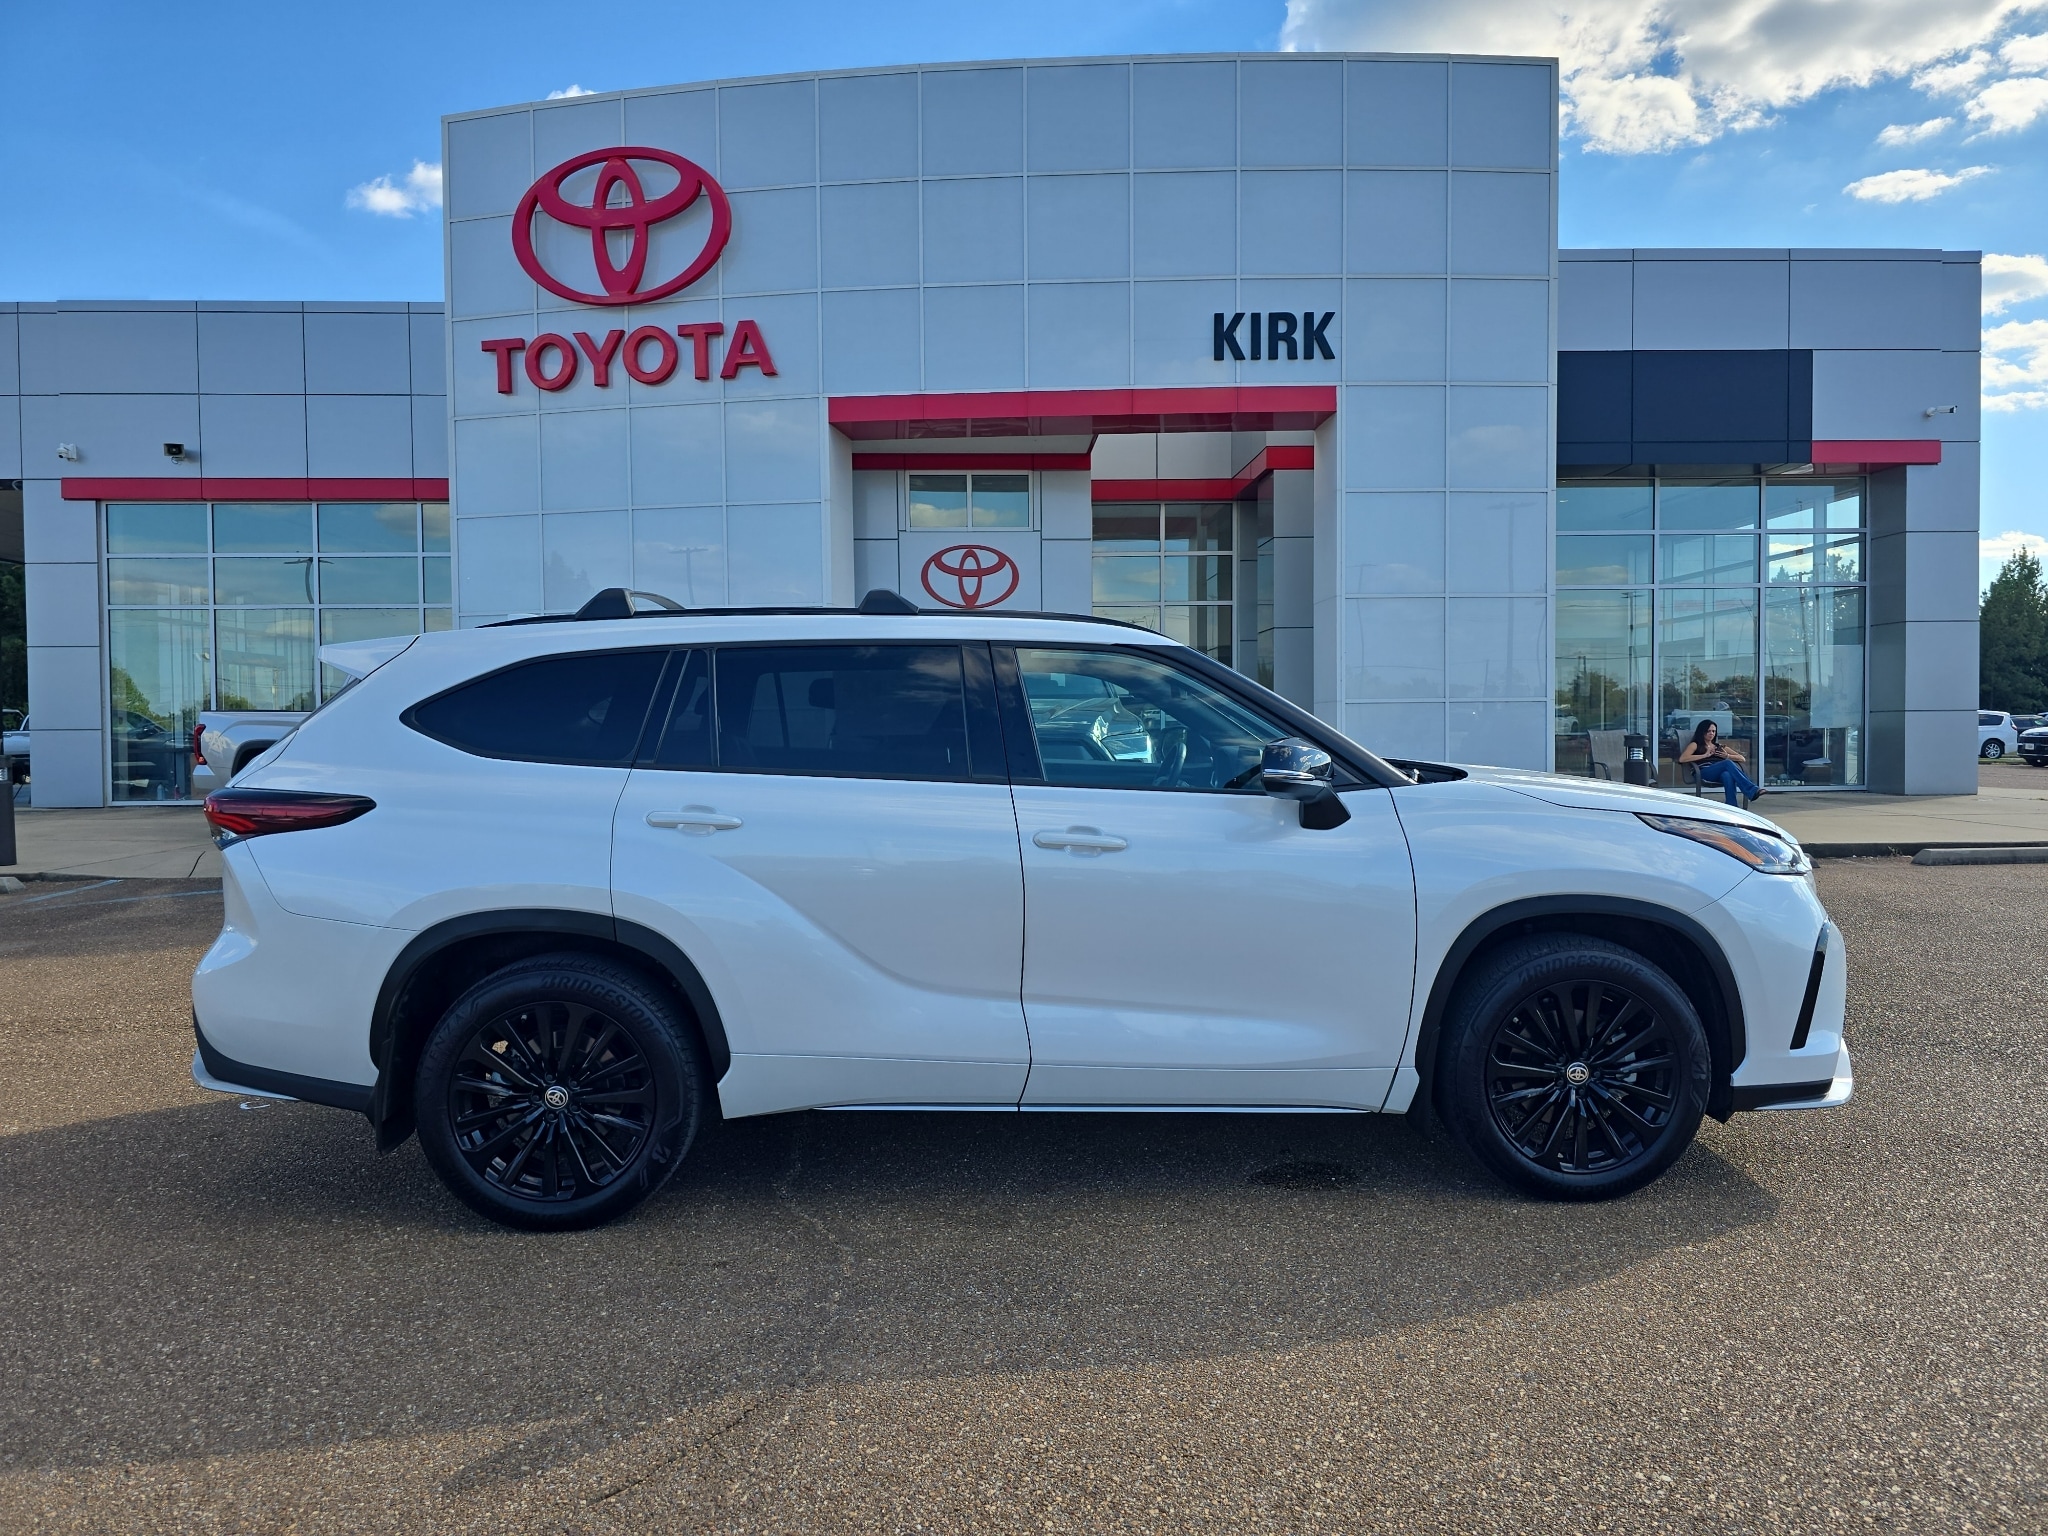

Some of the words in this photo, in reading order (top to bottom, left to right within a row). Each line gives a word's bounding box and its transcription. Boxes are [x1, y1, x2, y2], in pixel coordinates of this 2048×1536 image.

[481, 319, 779, 395] TOYOTA
[1213, 311, 1336, 361] KIRK
[1517, 954, 1645, 985] BRIDGESTONE
[539, 974, 663, 1038] BRIDGESTONE
